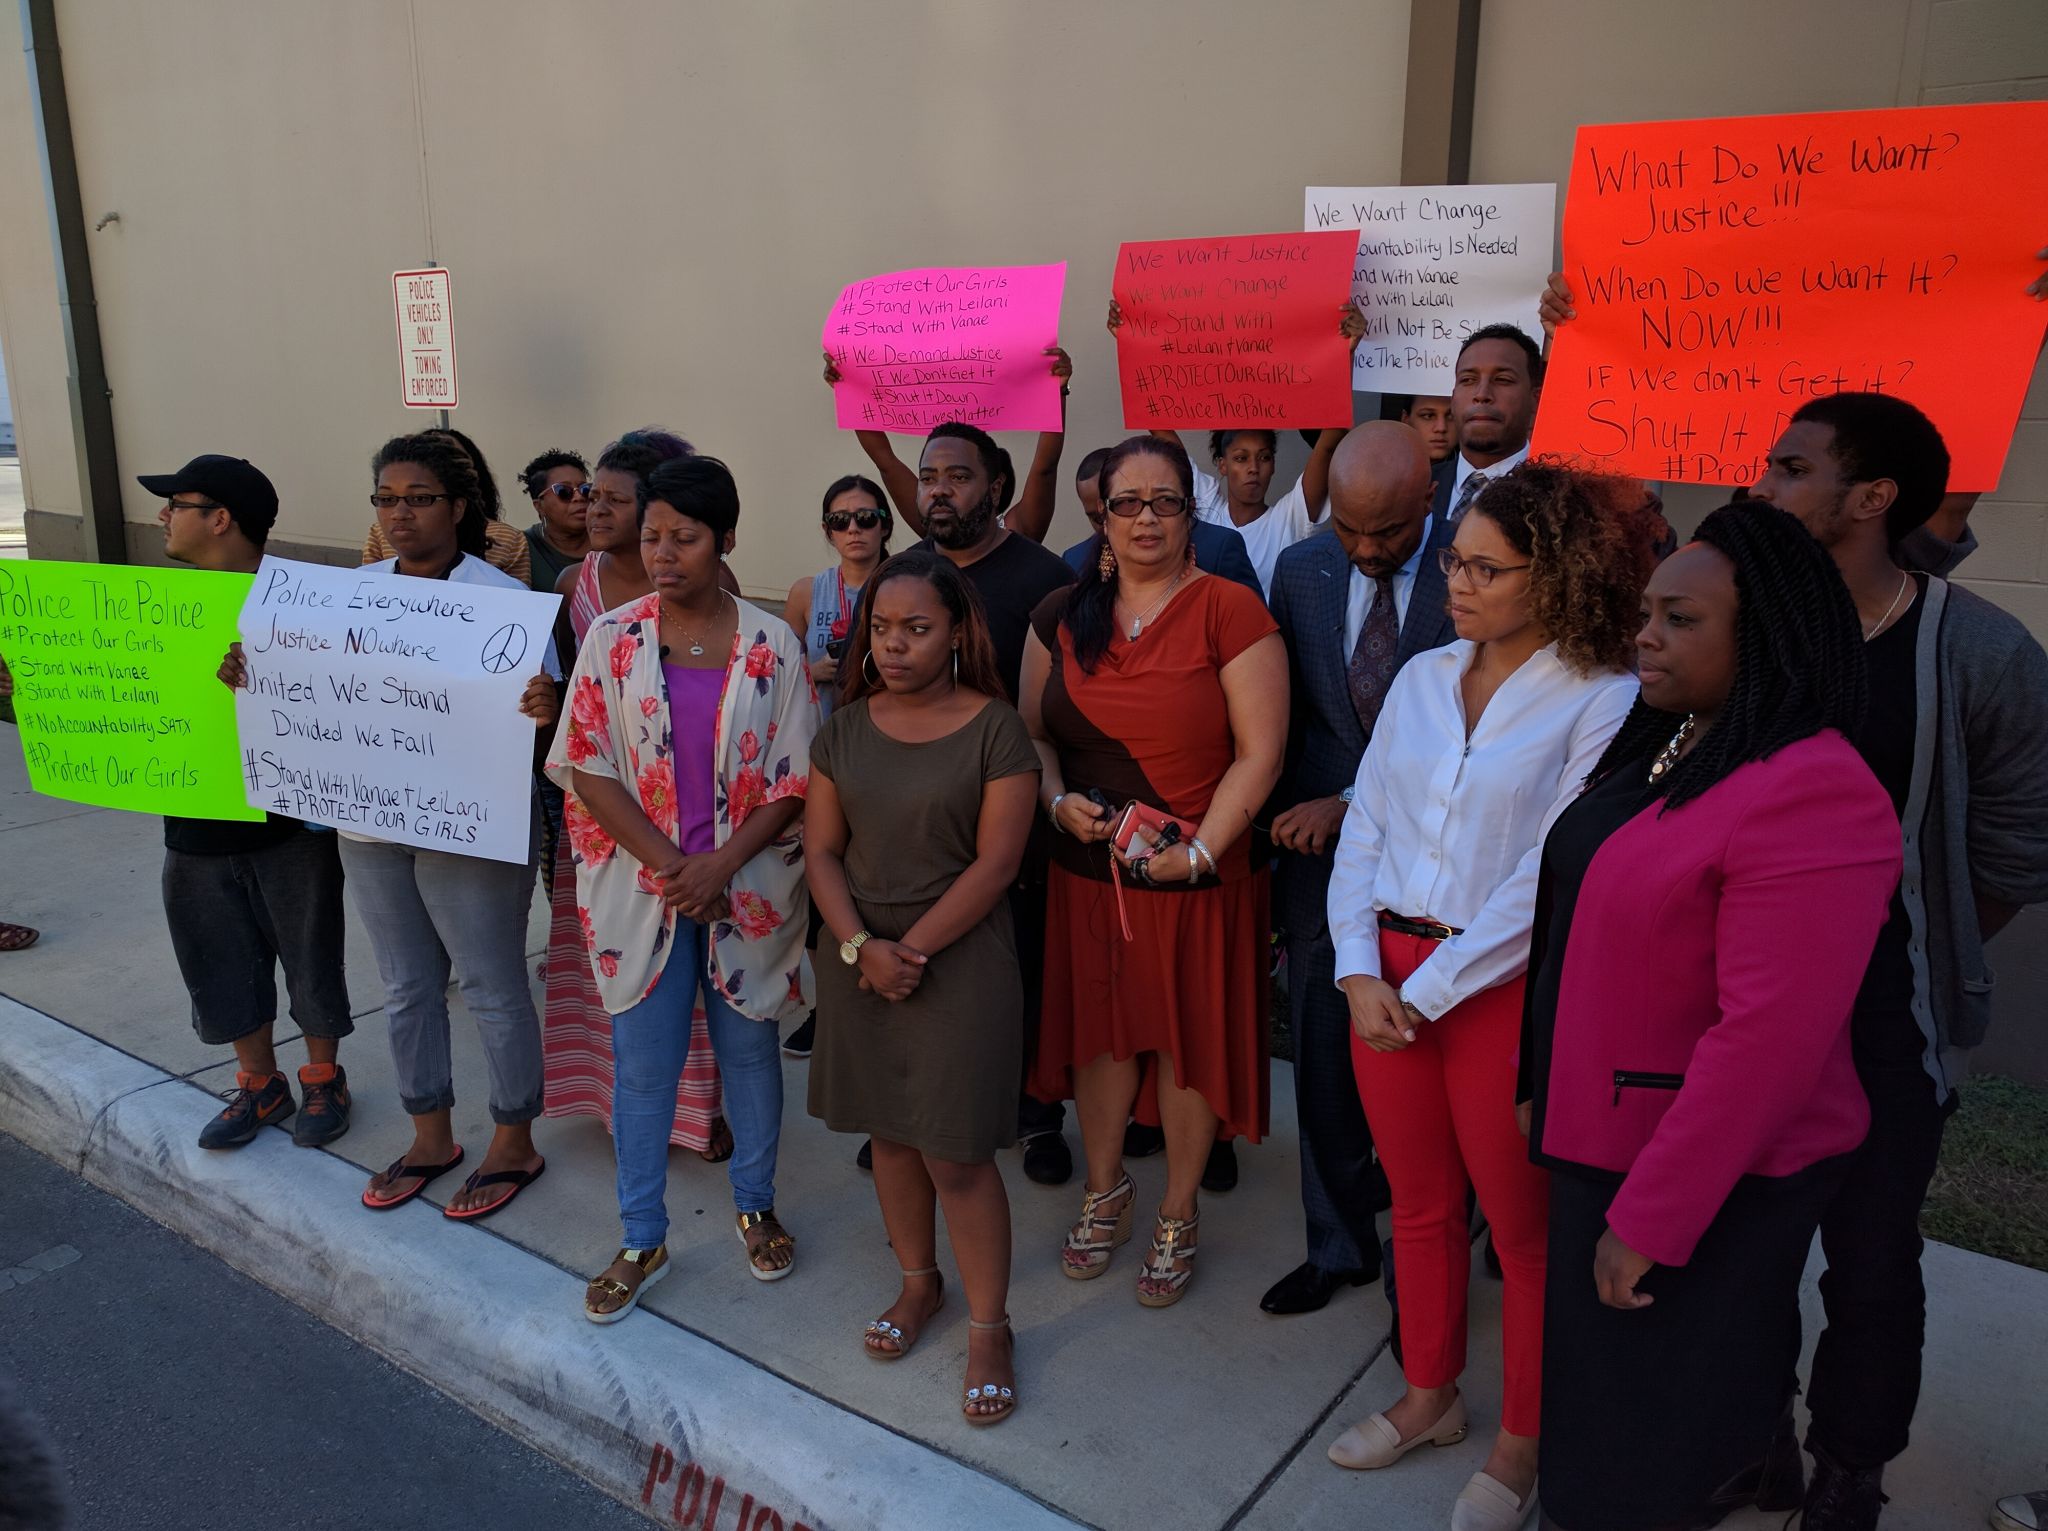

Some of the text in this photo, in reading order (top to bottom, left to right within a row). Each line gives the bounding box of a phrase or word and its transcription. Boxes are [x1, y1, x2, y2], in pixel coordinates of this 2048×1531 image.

[1591, 133, 1960, 195] What Do We Want?
[1313, 198, 1501, 230] We Want Change
[1622, 181, 1800, 246] Justice!!!
[1128, 244, 1312, 274] We Want Justice
[1356, 233, 1518, 260] ountability Is Needed
[1352, 265, 1460, 285] and With Vanae
[1582, 265, 1667, 305] When
[1680, 267, 1721, 301] Do
[1909, 254, 1958, 295] It?
[409, 280, 435, 300] POLICE
[918, 301, 953, 315] With
[959, 294, 1010, 311] Leilani
[1129, 275, 1288, 306] We Want Change
[1376, 290, 1406, 307] With
[407, 303, 442, 323] VEHICLES
[912, 321, 945, 334] With
[951, 314, 990, 330] Vanae
[1125, 314, 1158, 337] We
[1164, 309, 1225, 335] Stand
[417, 326, 434, 345] ONLY
[1397, 318, 1425, 337] Not
[1432, 319, 1452, 340] Be
[1641, 305, 1783, 351] NOW!!!
[415, 356, 442, 375] TOWING
[884, 344, 950, 365] Demand
[953, 343, 1003, 361] Justice
[1375, 347, 1400, 368] The
[1405, 347, 1449, 369] Police
[411, 377, 448, 396] ENFORCED
[890, 368, 911, 384] We
[950, 365, 975, 380] Get
[982, 366, 996, 378] It
[1587, 365, 1614, 389] IF
[1629, 364, 1679, 392] We
[1693, 362, 1761, 393] don't
[1778, 361, 1848, 396] Get
[1580, 399, 1697, 456] Shut
[1720, 411, 1748, 453] It
[1660, 453, 1769, 484] #Prot
[0, 568, 206, 630] Police The Police
[261, 568, 475, 622] Police Everywhere
[1, 625, 164, 653] #Protect Our Girls
[254, 613, 440, 662] Justice NOwhere
[70, 660, 103, 679] With
[108, 660, 150, 680] Vanae
[77, 684, 106, 701] With
[112, 686, 160, 705] Leilani
[329, 674, 368, 704] We
[381, 676, 450, 714] Stand
[272, 710, 435, 756] Divided We Fall
[28, 742, 199, 788] #Protect Our Girls
[244, 748, 313, 791] #Stand
[316, 769, 348, 797] With
[352, 773, 400, 807] Vanae
[272, 789, 477, 844] #PROTECT OUR GIRLS
